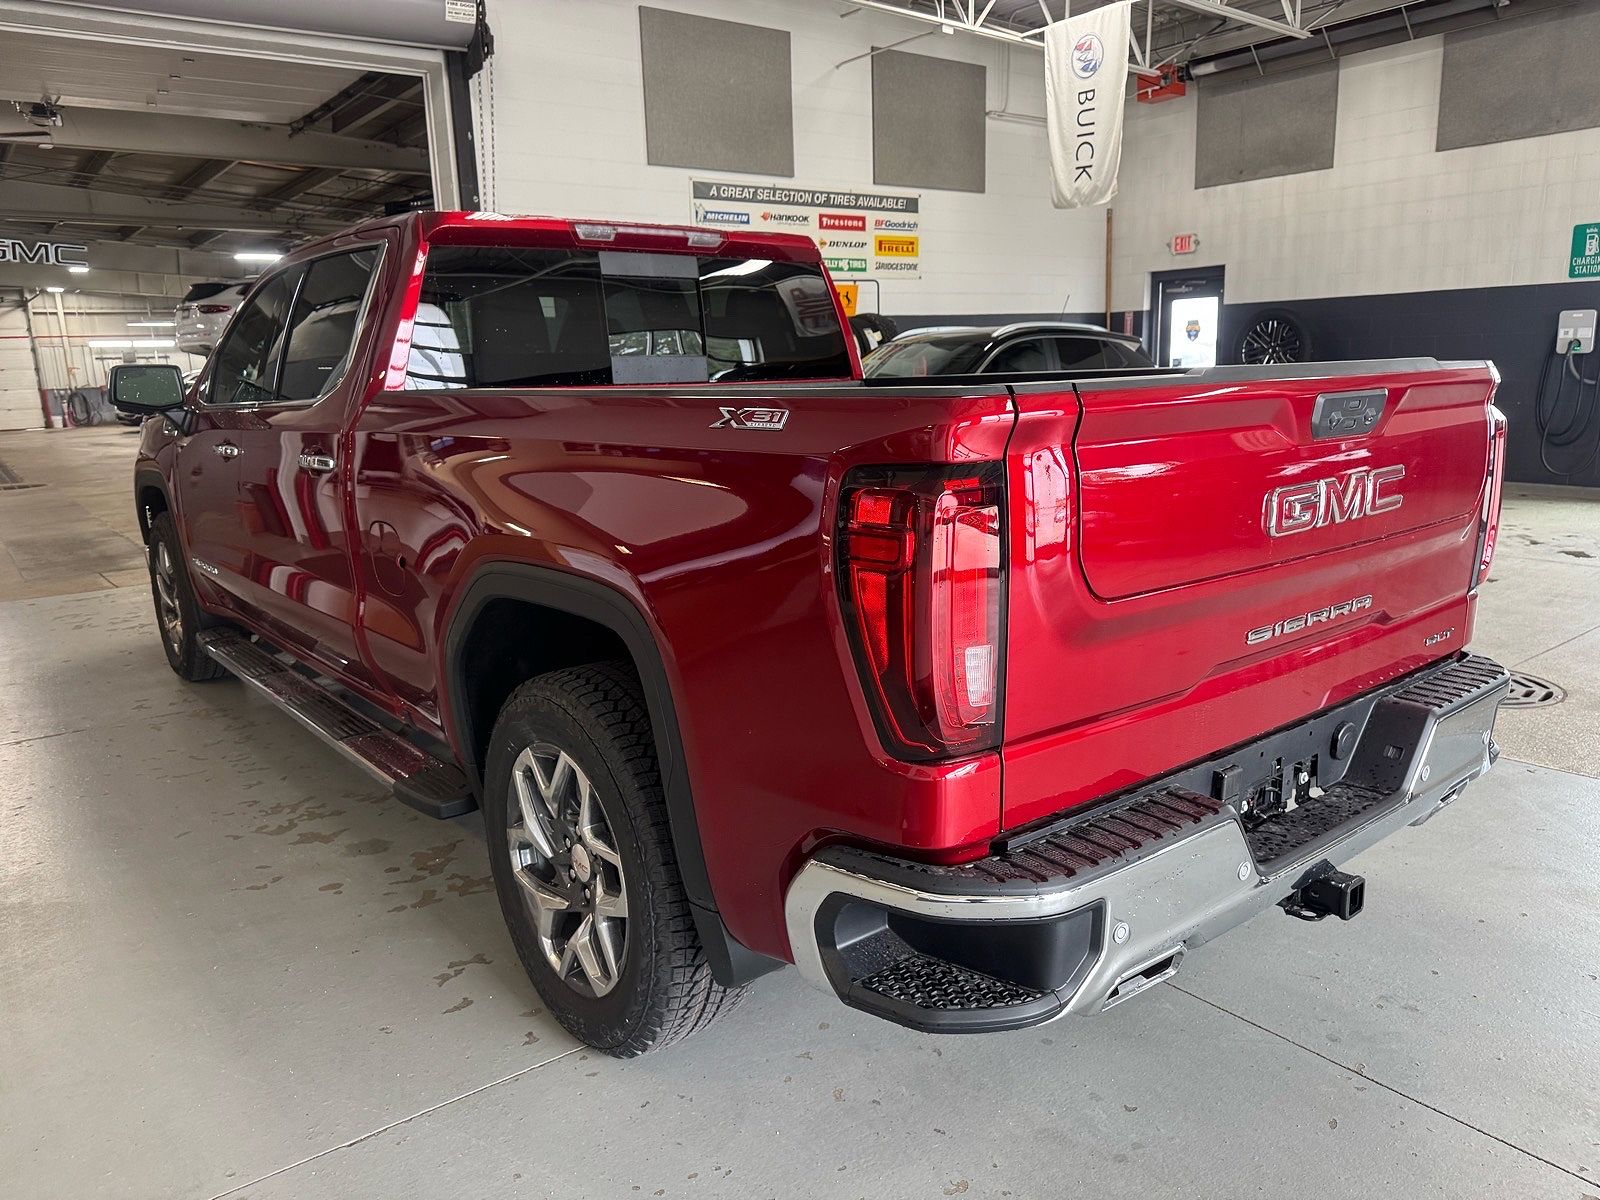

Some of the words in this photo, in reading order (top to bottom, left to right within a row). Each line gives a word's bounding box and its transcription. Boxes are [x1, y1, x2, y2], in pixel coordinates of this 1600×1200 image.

[1074, 88, 1096, 183] BUICK
[709, 185, 718, 197] A
[720, 186, 755, 199] GREAT
[757, 188, 813, 204] SELECTION
[815, 193, 828, 205] OF
[829, 195, 856, 207] TIRES
[856, 197, 907, 210] AVAILABLE!
[706, 212, 749, 222] MICHELIN
[821, 216, 863, 228] Firestone
[874, 219, 918, 229] BFGoodrich
[828, 240, 867, 249] DUNLOP
[878, 239, 915, 253] PIRELLI
[1174, 235, 1192, 252] EXIT
[0, 238, 88, 268] MC
[874, 261, 918, 271] BRIDGESTONE
[709, 406, 789, 430] X31
[1261, 464, 1405, 537] GMC
[1246, 594, 1373, 645] SIERRA
